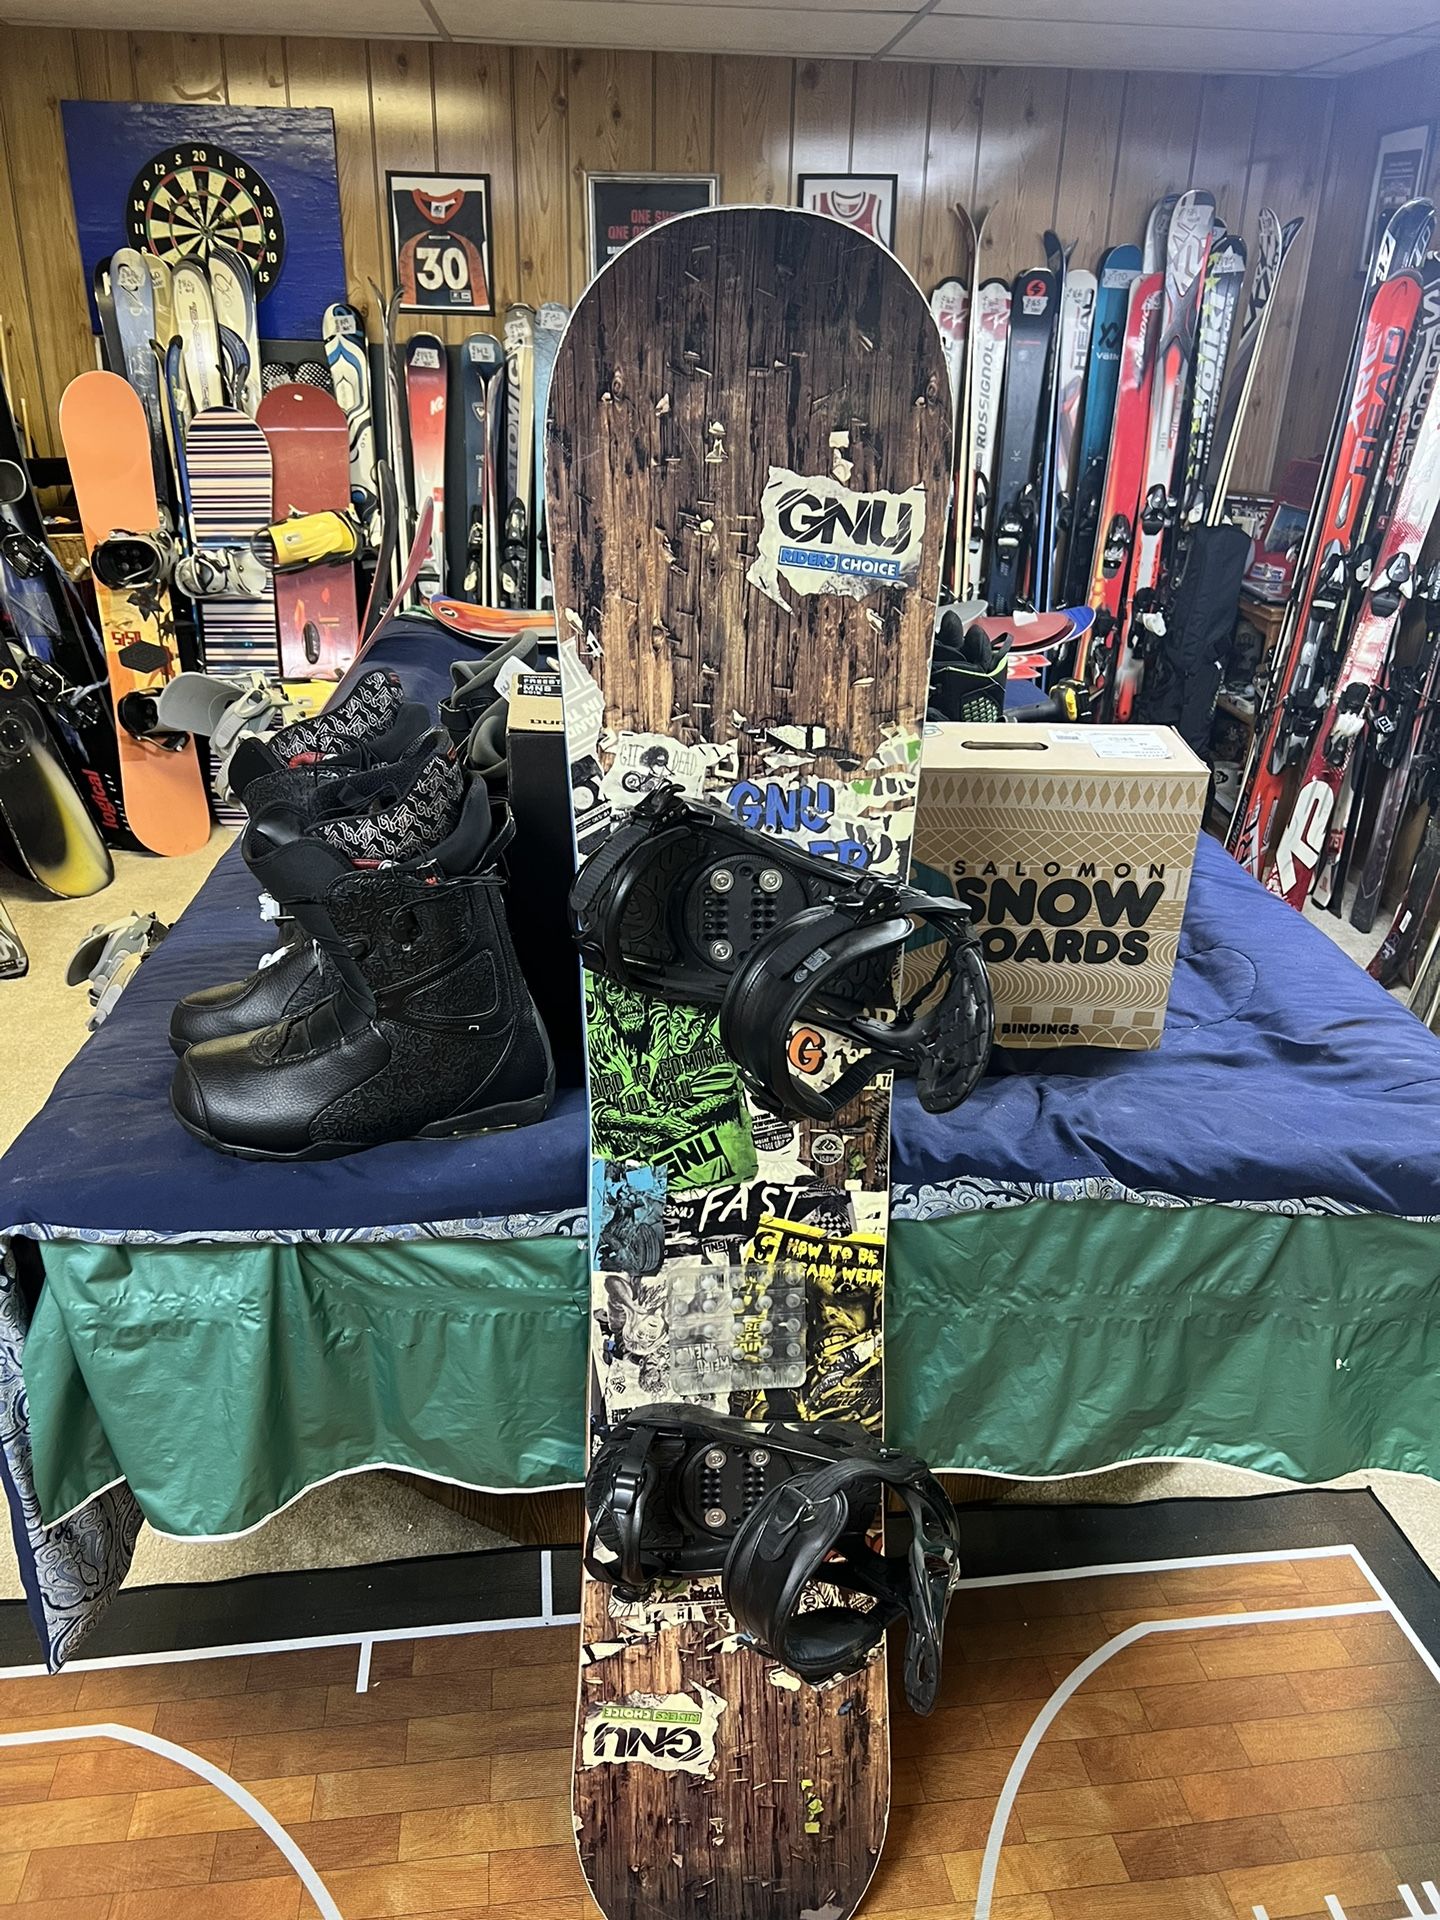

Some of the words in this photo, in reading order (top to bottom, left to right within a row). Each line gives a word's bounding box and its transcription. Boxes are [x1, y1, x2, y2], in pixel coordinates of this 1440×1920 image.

[174, 154, 182, 165] 5
[192, 150, 207, 162] 20
[218, 155, 223, 167] 1
[154, 163, 166, 175] 12
[235, 167, 246, 179] 18
[142, 180, 150, 191] 9
[253, 185, 261, 196] 4
[134, 200, 145, 212] 14
[263, 206, 274, 218] 13
[631, 209, 651, 224] ONE
[655, 210, 680, 222] SH
[134, 223, 145, 235] 11
[269, 229, 276, 241] 6
[608, 226, 629, 240] ONE
[266, 252, 277, 263] 10
[415, 247, 469, 291] 30
[258, 271, 270, 283] 15
[975, 343, 995, 449] ROSSIGNOL
[1349, 326, 1406, 477] HEAD
[430, 396, 445, 416] K2
[775, 488, 913, 555] GNU
[780, 547, 837, 569] RIDERS
[841, 558, 897, 577] CHOICE
[82, 769, 119, 829] logical
[727, 780, 835, 833] GNU
[953, 859, 1165, 879] SALOMON
[955, 878, 1165, 928] SNOW
[980, 927, 1150, 966] OARDS
[1001, 1023, 1080, 1036] BINDINGS
[632, 1064, 650, 1086] IS
[659, 1045, 729, 1081] COMING
[618, 1091, 651, 1116] FOR
[656, 1079, 692, 1104] YOU
[662, 1204, 695, 1219] GNU
[698, 1185, 809, 1232] FAST
[786, 1237, 823, 1263] HOW
[828, 1243, 853, 1264] TO
[858, 1247, 880, 1267] BE
[604, 1707, 651, 1719] CHOICE
[654, 1710, 701, 1723] RIDERS
[594, 1722, 704, 1762] GNU
